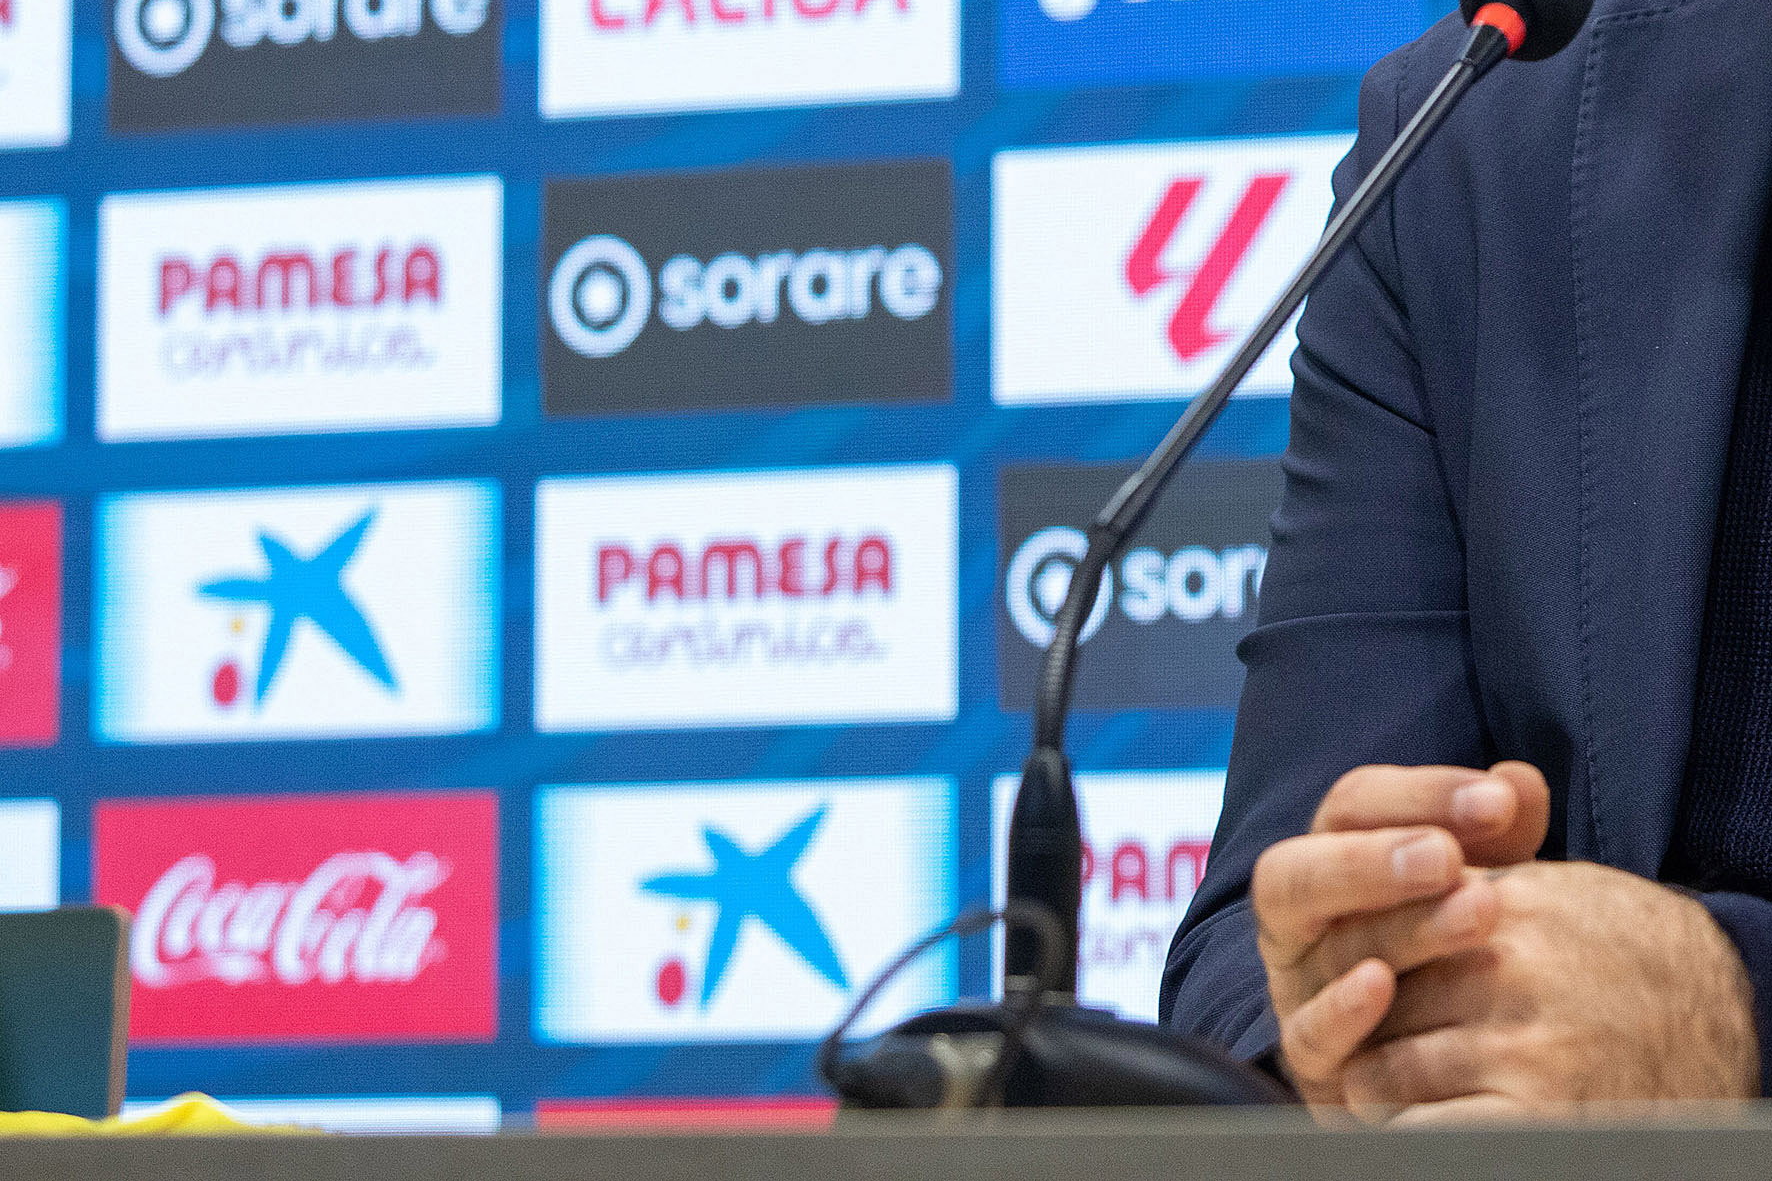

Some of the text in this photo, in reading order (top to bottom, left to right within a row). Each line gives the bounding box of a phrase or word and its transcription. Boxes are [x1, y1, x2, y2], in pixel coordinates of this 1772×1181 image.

[158, 245, 441, 316] PAMESA
[660, 245, 941, 329] sorare
[597, 535, 893, 603] PAMESA
[1118, 542, 1268, 624] sor
